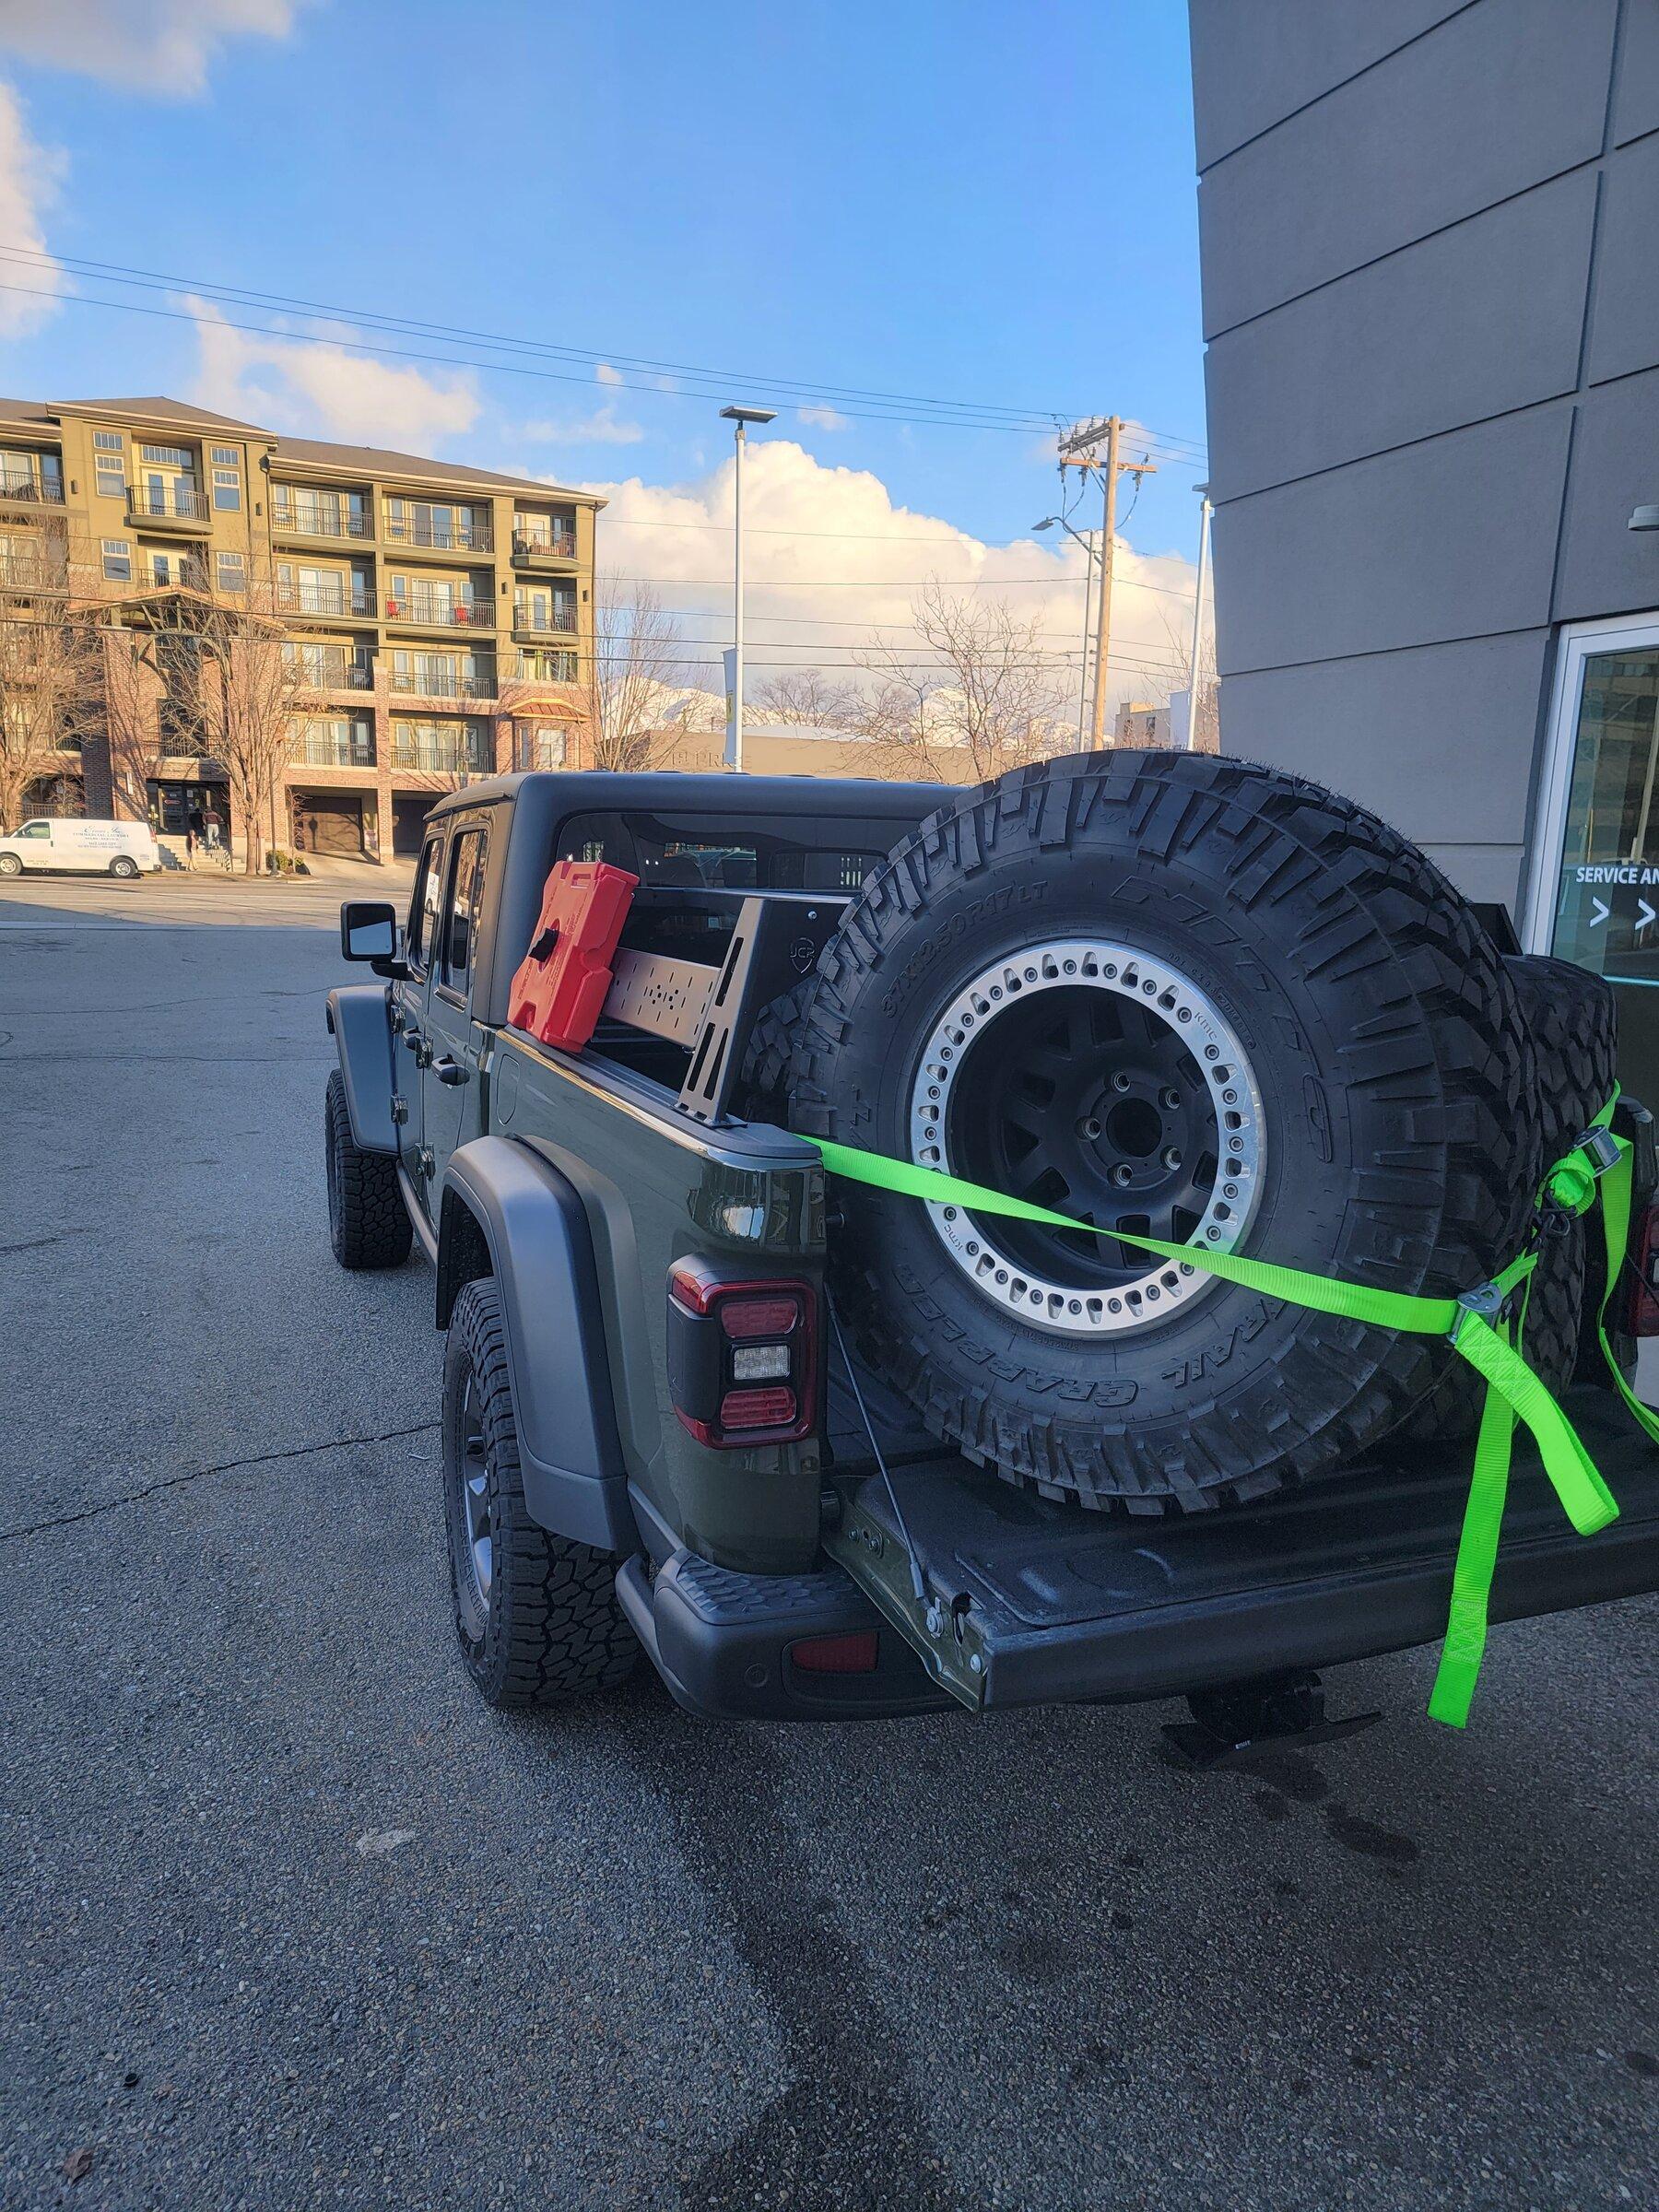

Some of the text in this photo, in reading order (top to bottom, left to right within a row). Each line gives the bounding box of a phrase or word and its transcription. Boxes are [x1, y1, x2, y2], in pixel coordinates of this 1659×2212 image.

[1576, 866, 1659, 886] SERVICE AN
[891, 1266, 1139, 1407] GRAPPLER
